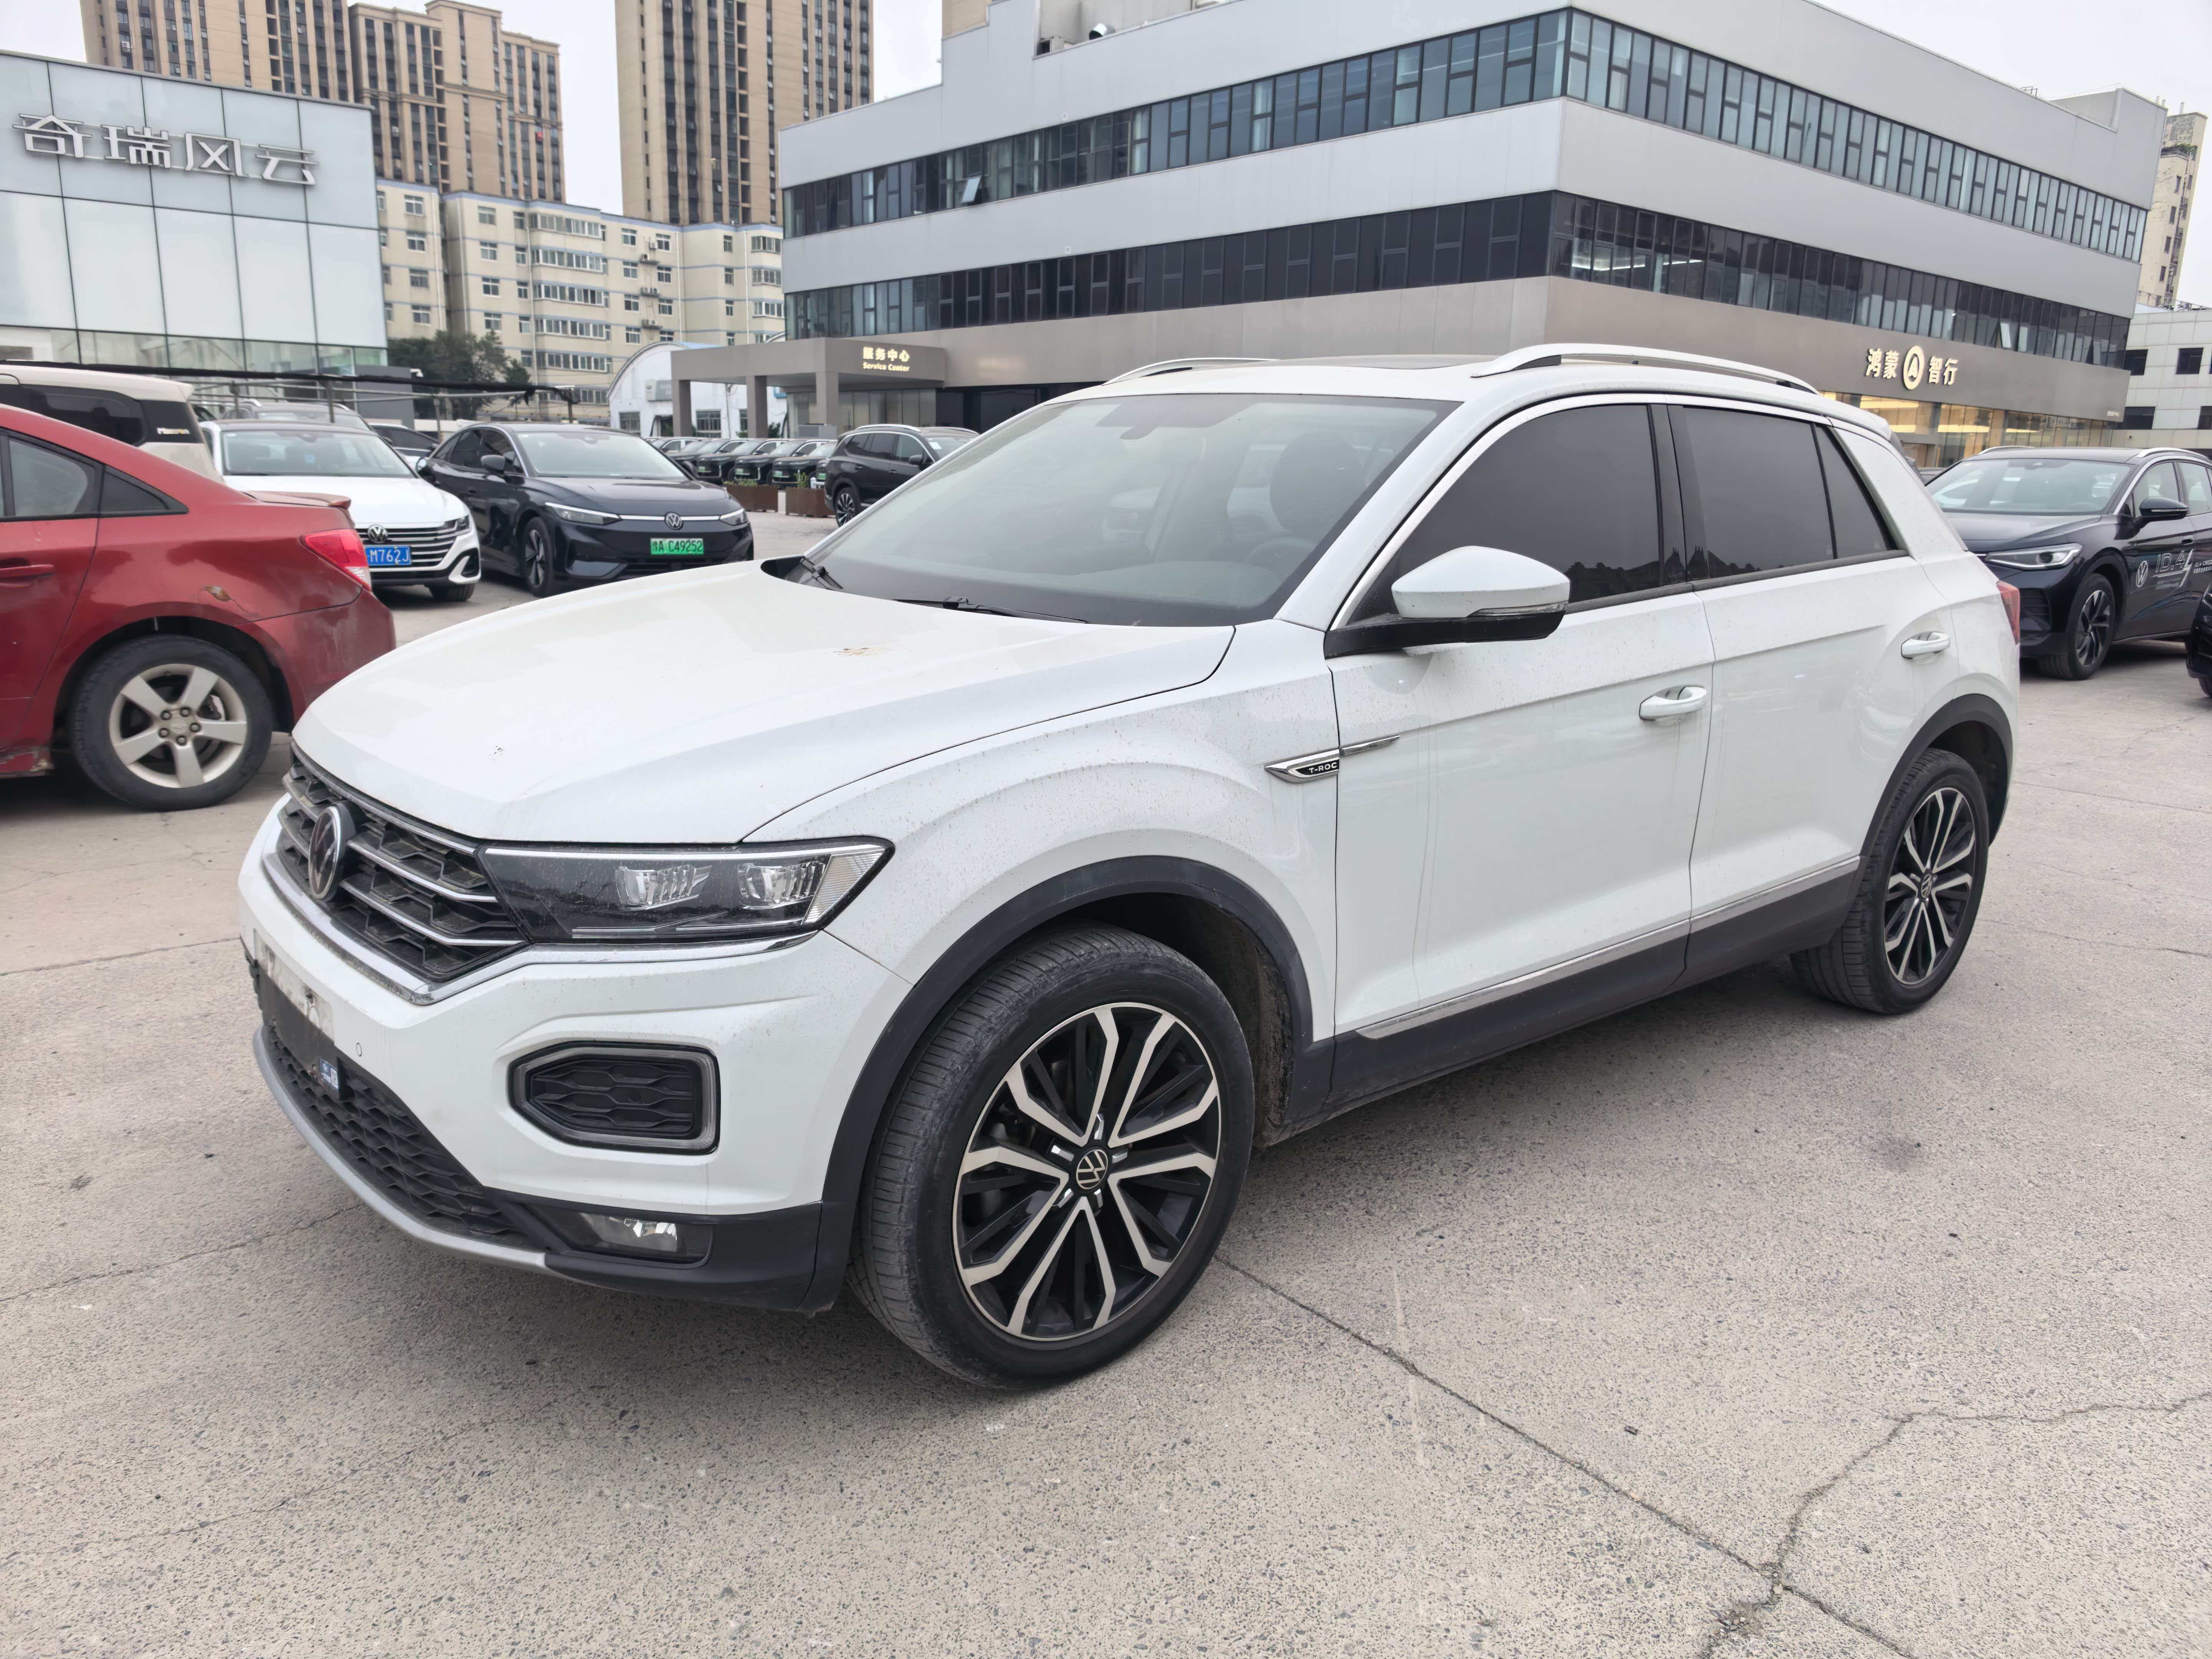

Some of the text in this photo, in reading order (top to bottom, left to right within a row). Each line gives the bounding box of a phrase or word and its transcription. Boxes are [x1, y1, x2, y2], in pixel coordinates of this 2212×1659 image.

[12, 113, 320, 186] 奇瑞风云
[863, 347, 909, 362] 服务中心
[863, 362, 887, 370] Service
[1866, 348, 1900, 379] 鸿蒙
[1929, 356, 1959, 385] 智行
[1309, 762, 1337, 773] T-ROC
